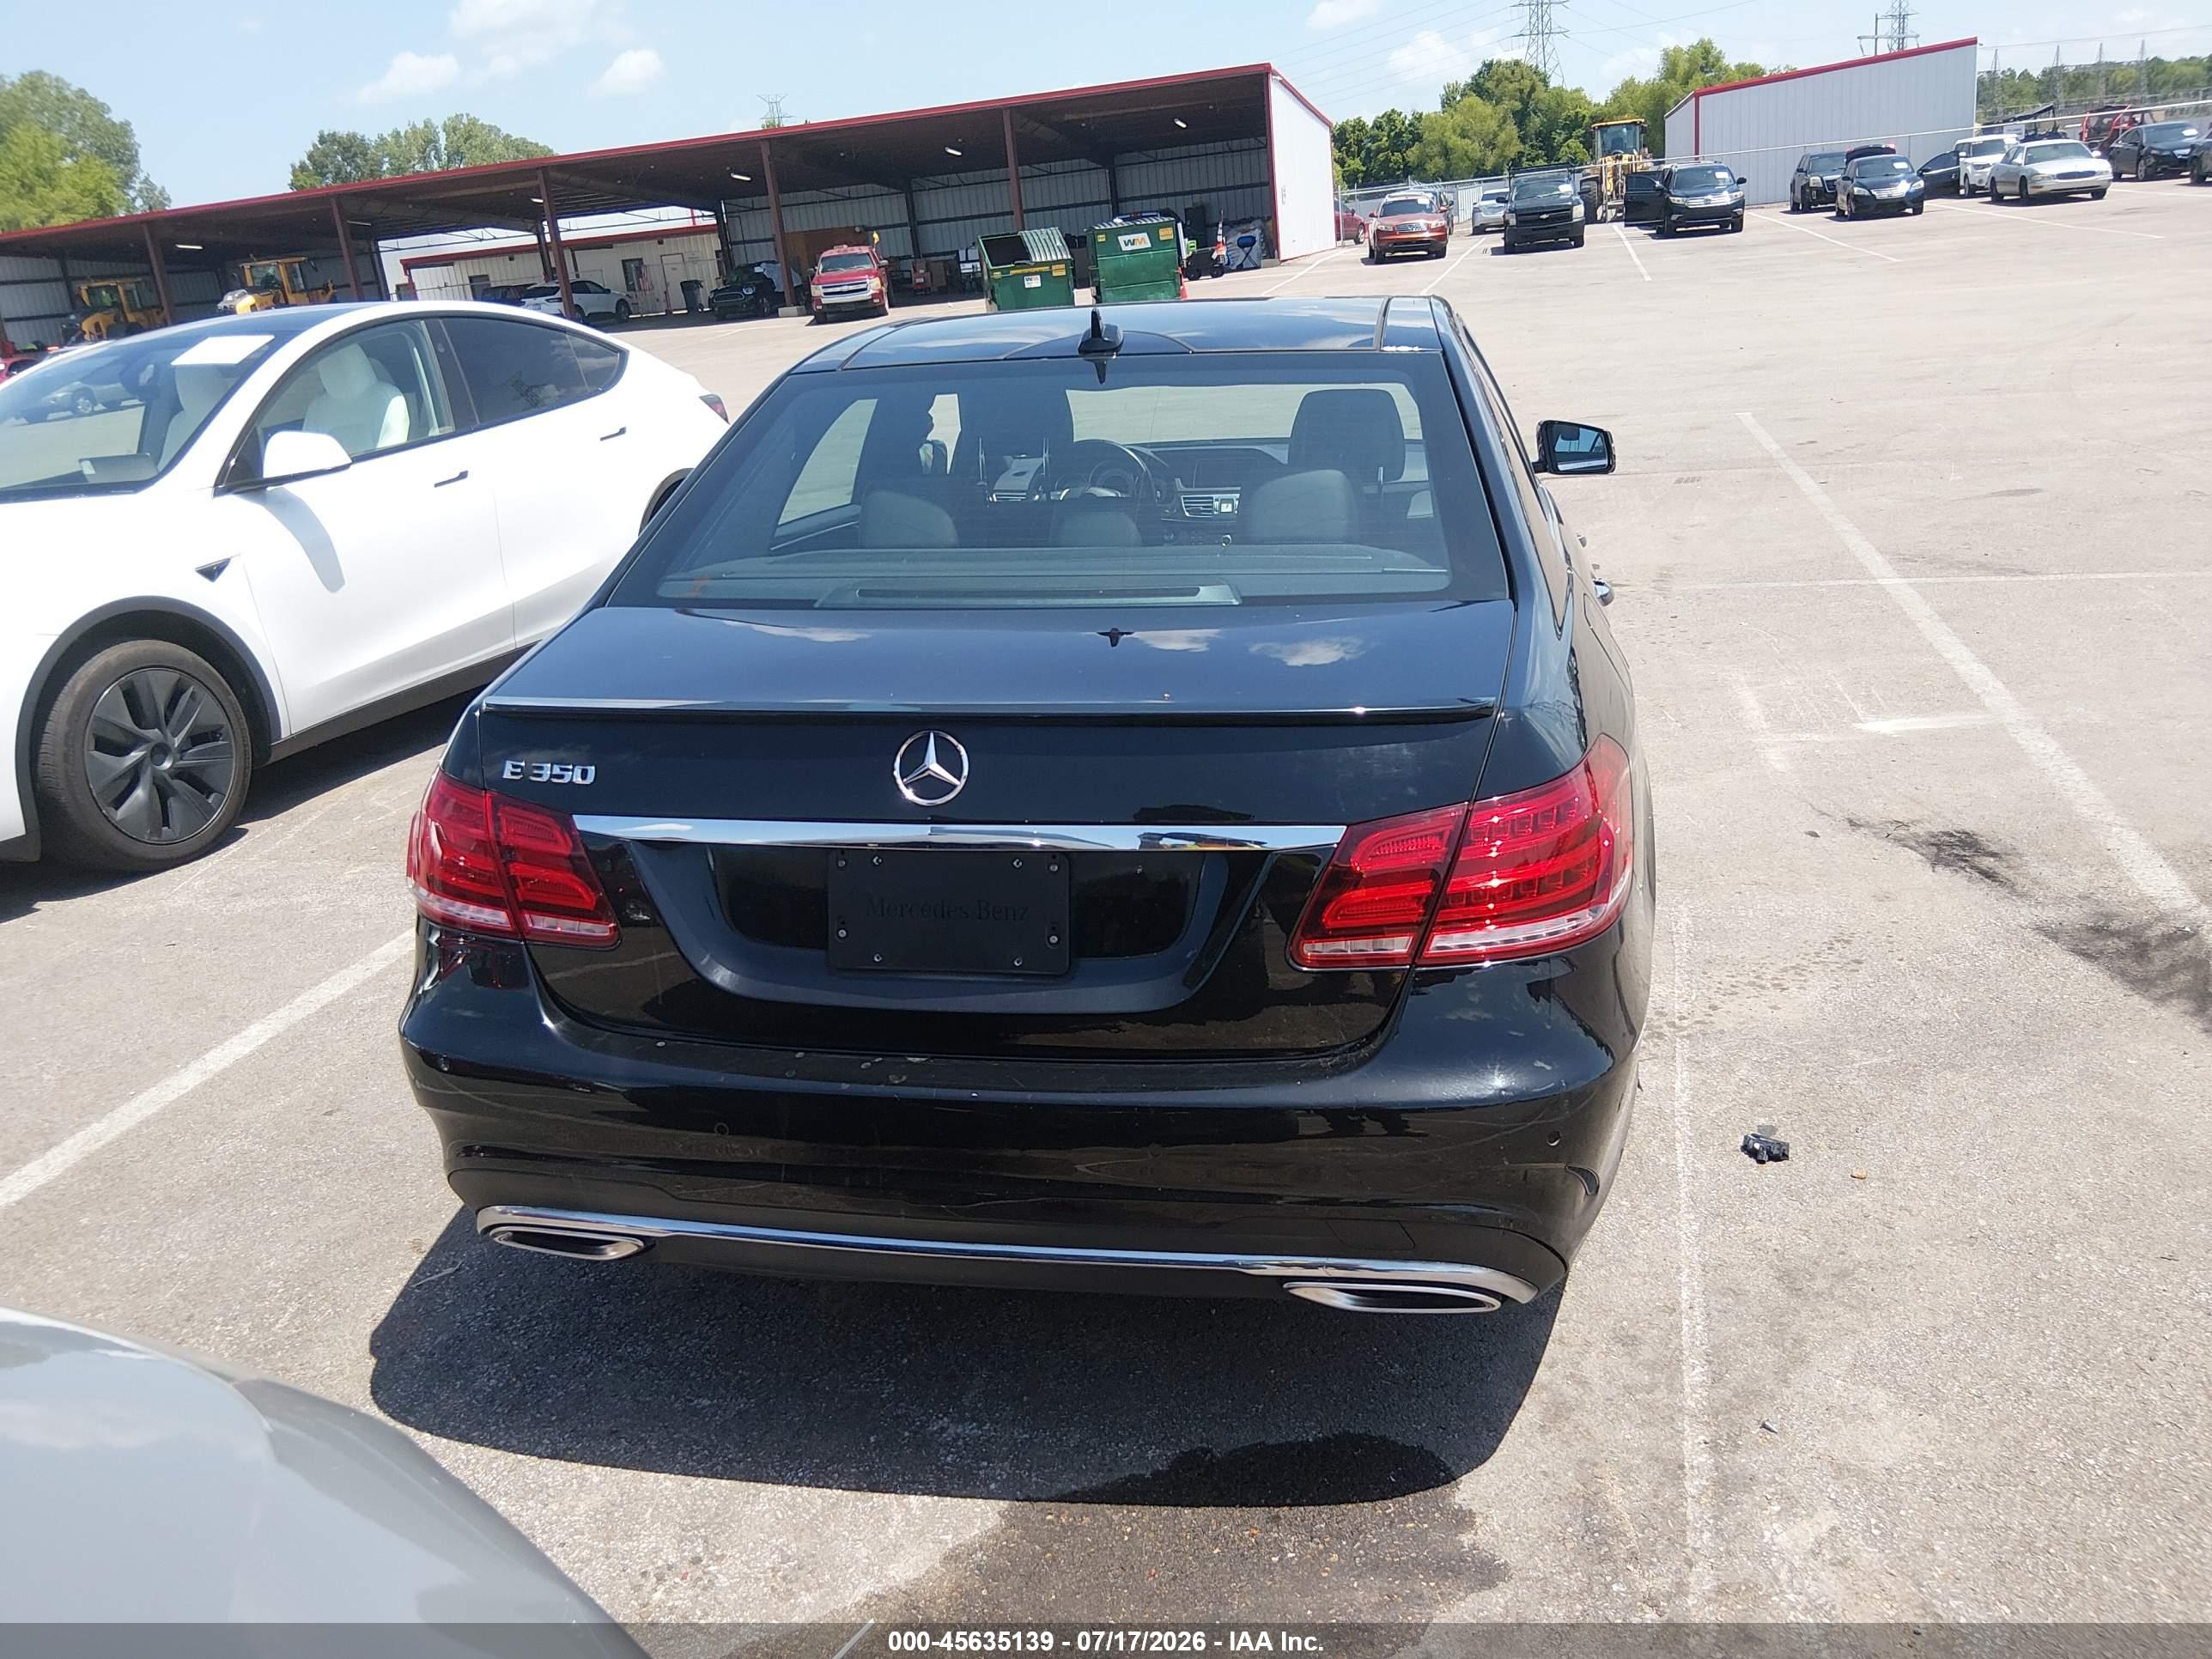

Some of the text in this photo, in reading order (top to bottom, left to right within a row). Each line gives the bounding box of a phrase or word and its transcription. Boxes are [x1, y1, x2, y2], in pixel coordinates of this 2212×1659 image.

[1123, 236, 1147, 247] WM
[502, 760, 596, 785] E 350
[866, 897, 1030, 921] Mercedes Benz
